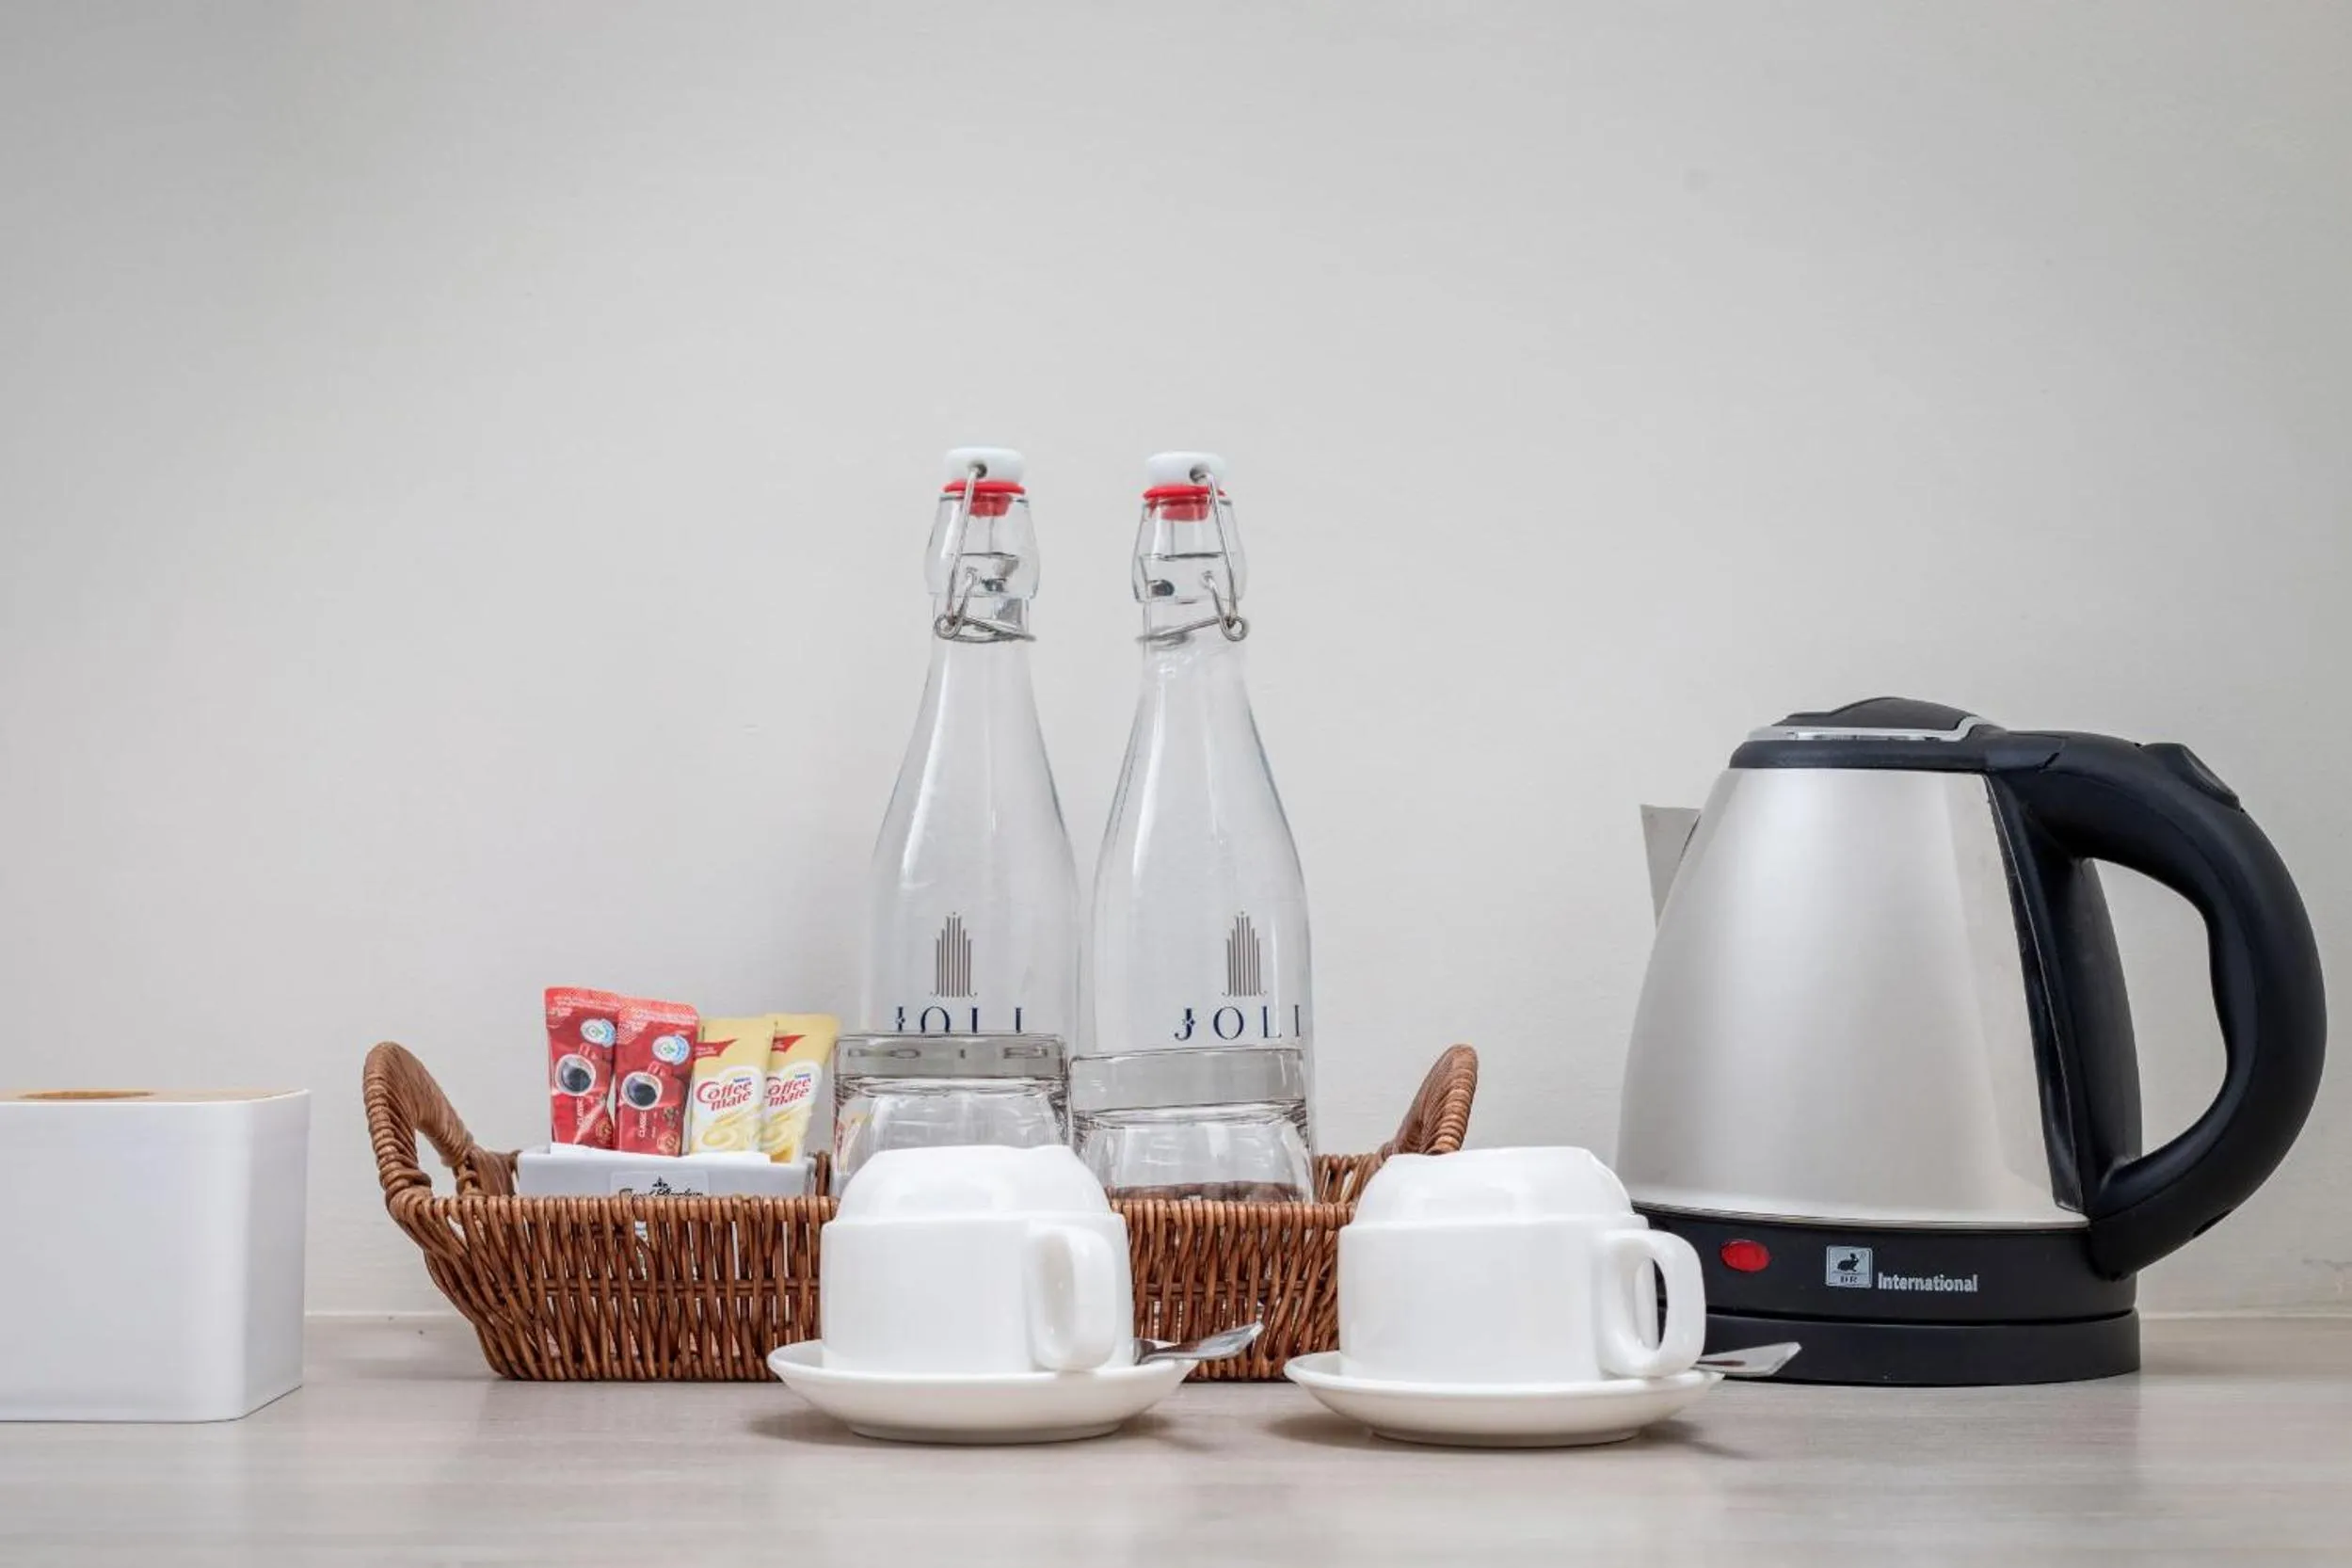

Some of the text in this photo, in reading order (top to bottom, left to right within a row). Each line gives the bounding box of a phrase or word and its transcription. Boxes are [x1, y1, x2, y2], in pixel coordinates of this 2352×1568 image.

[1175, 1004, 1302, 1041] JOLI
[696, 1080, 753, 1103] Coffee
[711, 1091, 752, 1111] mate
[769, 1088, 809, 1107] mate
[1878, 1272, 1978, 1292] International
